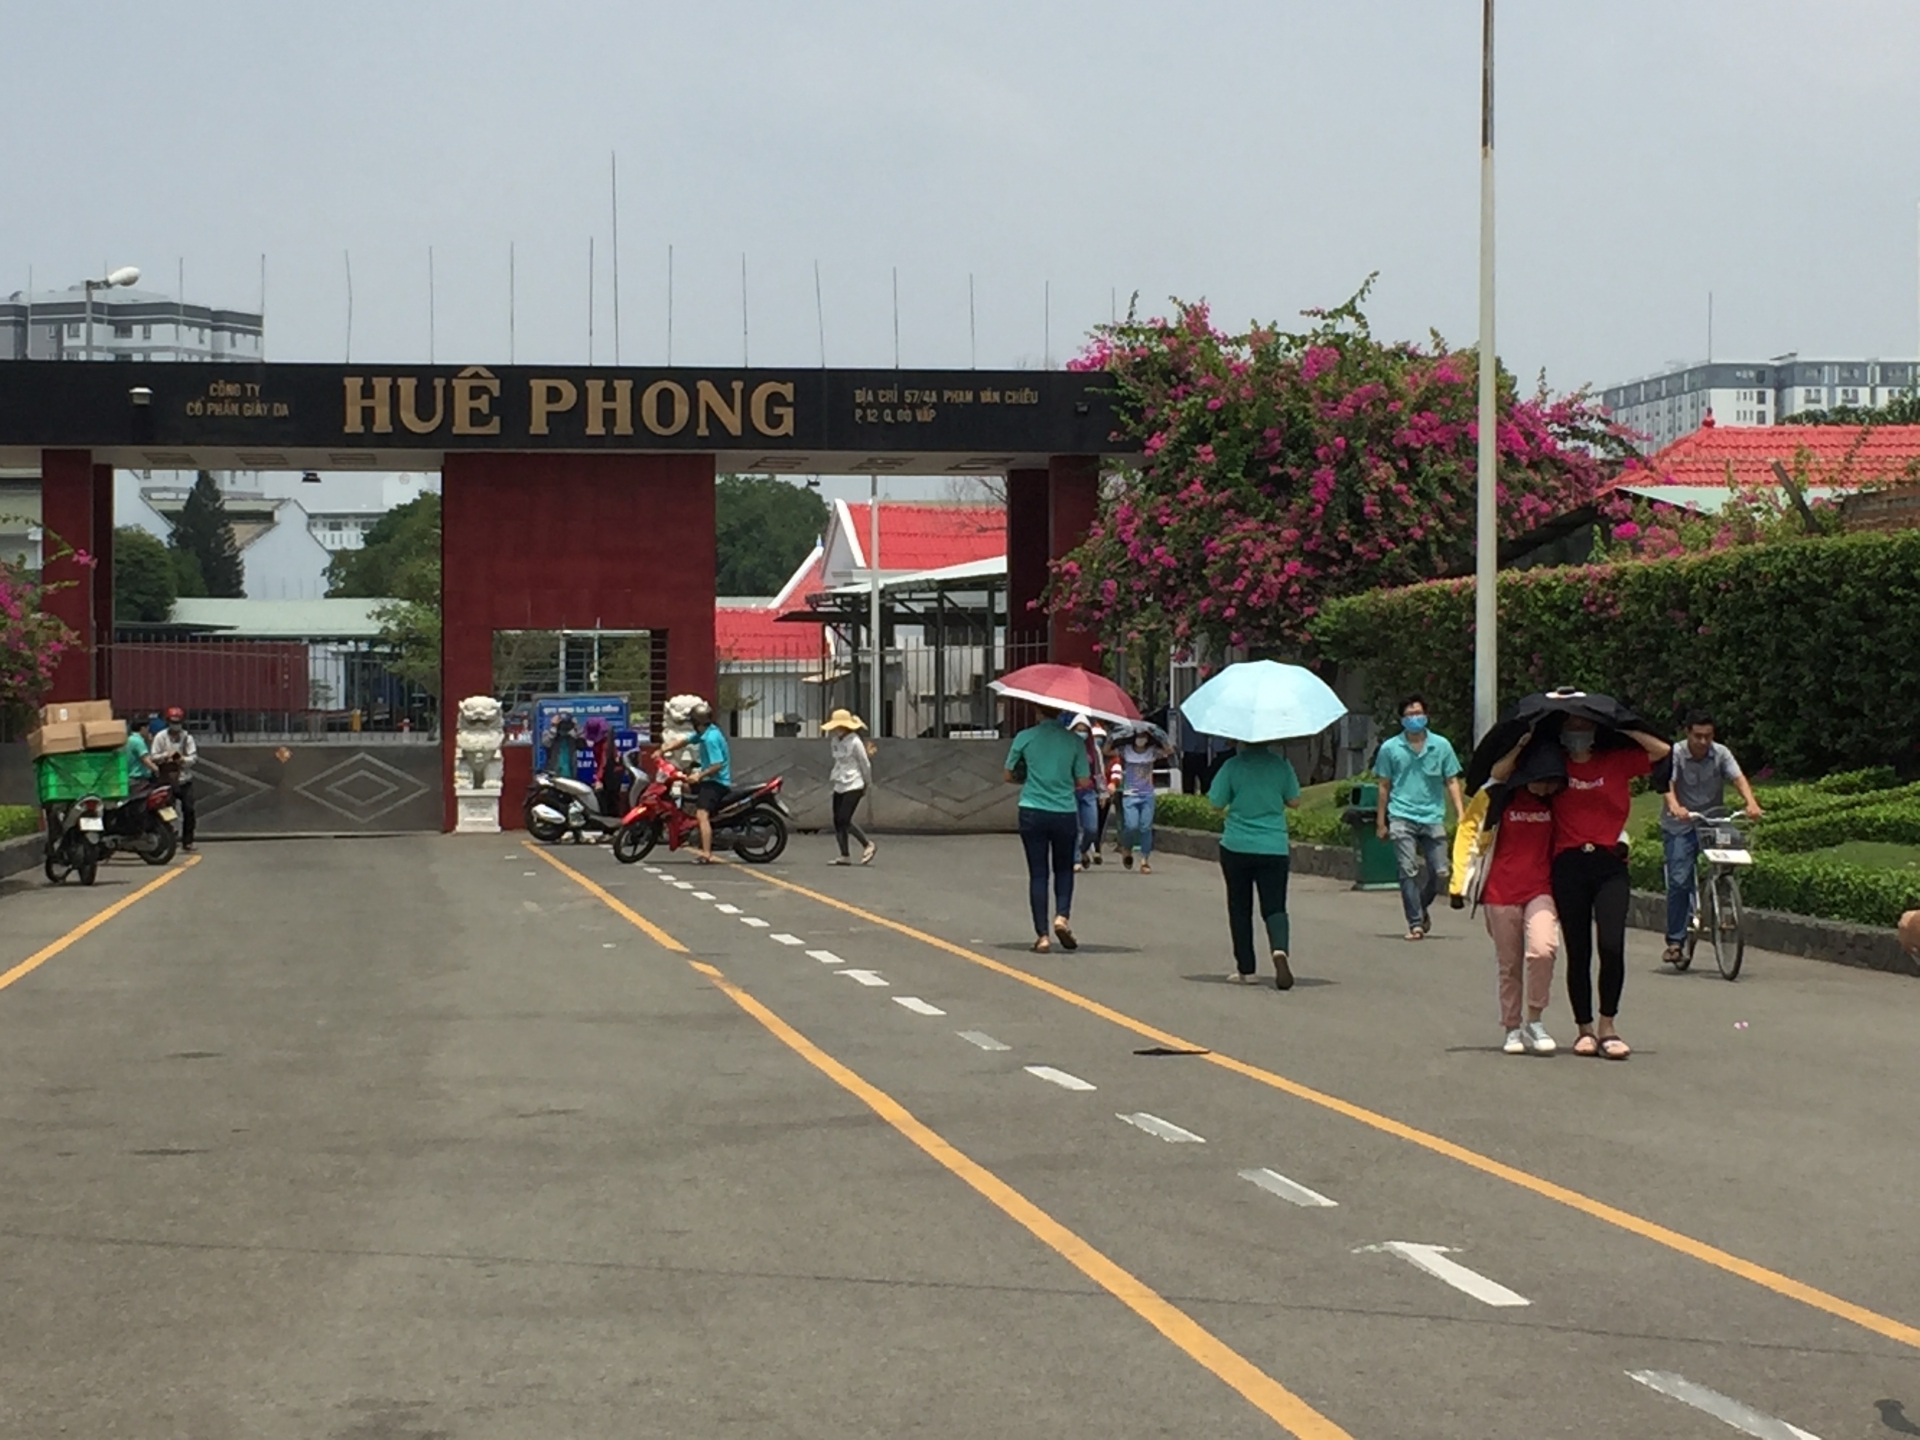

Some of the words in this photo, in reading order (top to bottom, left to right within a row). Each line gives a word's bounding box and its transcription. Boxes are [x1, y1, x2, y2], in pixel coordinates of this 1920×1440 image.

[209, 379, 241, 397] CÔNG
[245, 383, 261, 397] TY
[273, 403, 289, 417] DA
[343, 365, 501, 435] HUÊ
[529, 379, 796, 437] PHONG
